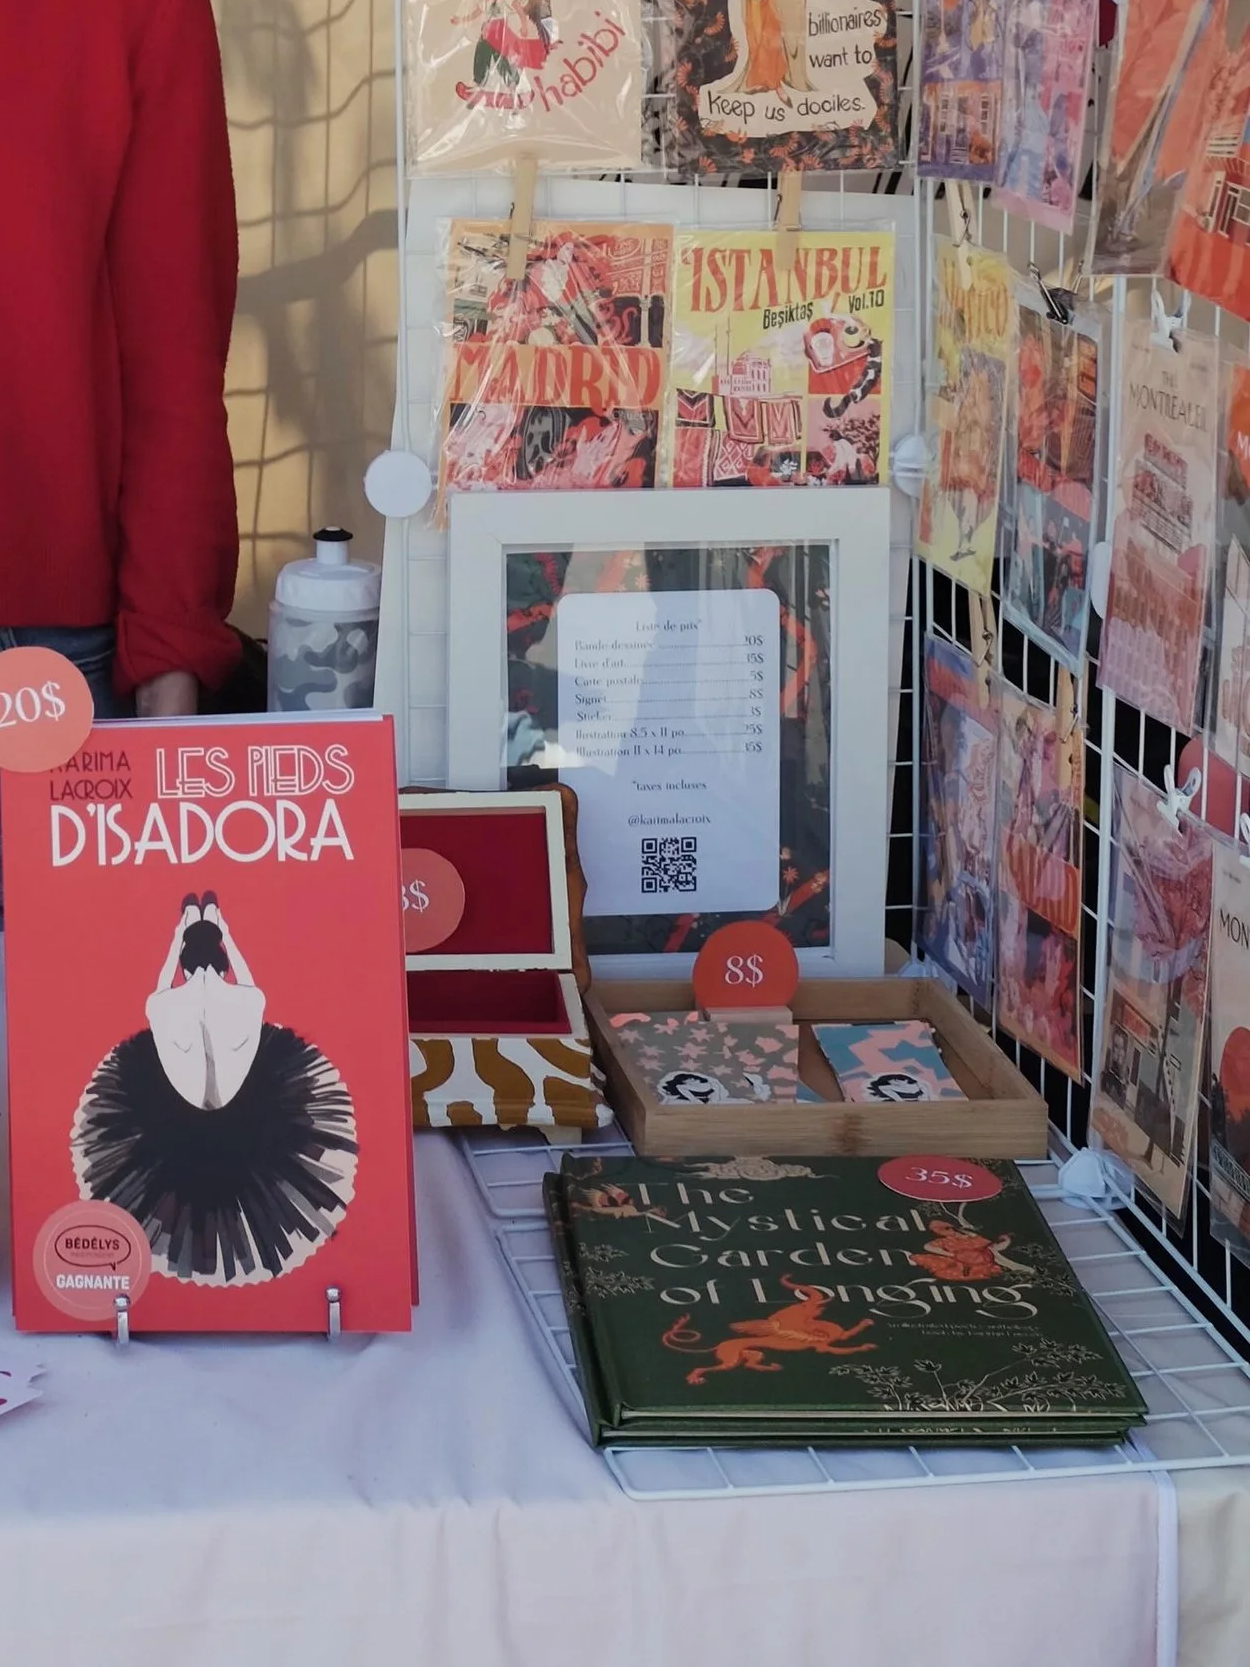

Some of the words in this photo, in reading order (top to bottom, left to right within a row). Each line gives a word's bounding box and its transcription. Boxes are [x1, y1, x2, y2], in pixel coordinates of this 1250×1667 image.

[808, 3, 882, 38] billionaires
[533, 10, 627, 113] habibi
[809, 49, 849, 69] want
[852, 46, 873, 67] to
[764, 104, 787, 124] us
[680, 245, 887, 314] ISTANBUL
[451, 340, 661, 417] MADRID
[663, 619, 676, 630] de
[155, 746, 235, 799] LES
[247, 744, 355, 797] PIEDS
[50, 778, 133, 801] LACROIX
[51, 797, 354, 867] D'ISADORA
[724, 953, 765, 990] 8$
[905, 1165, 975, 1190] 35$
[626, 1181, 755, 1206] The
[644, 1208, 929, 1242] Mystical
[65, 1236, 120, 1251] BÉDÉLYS
[650, 1241, 918, 1269] Garden
[56, 1273, 130, 1290] GAGNANTE
[659, 1278, 725, 1306] of
[752, 1276, 1041, 1320] Longing
